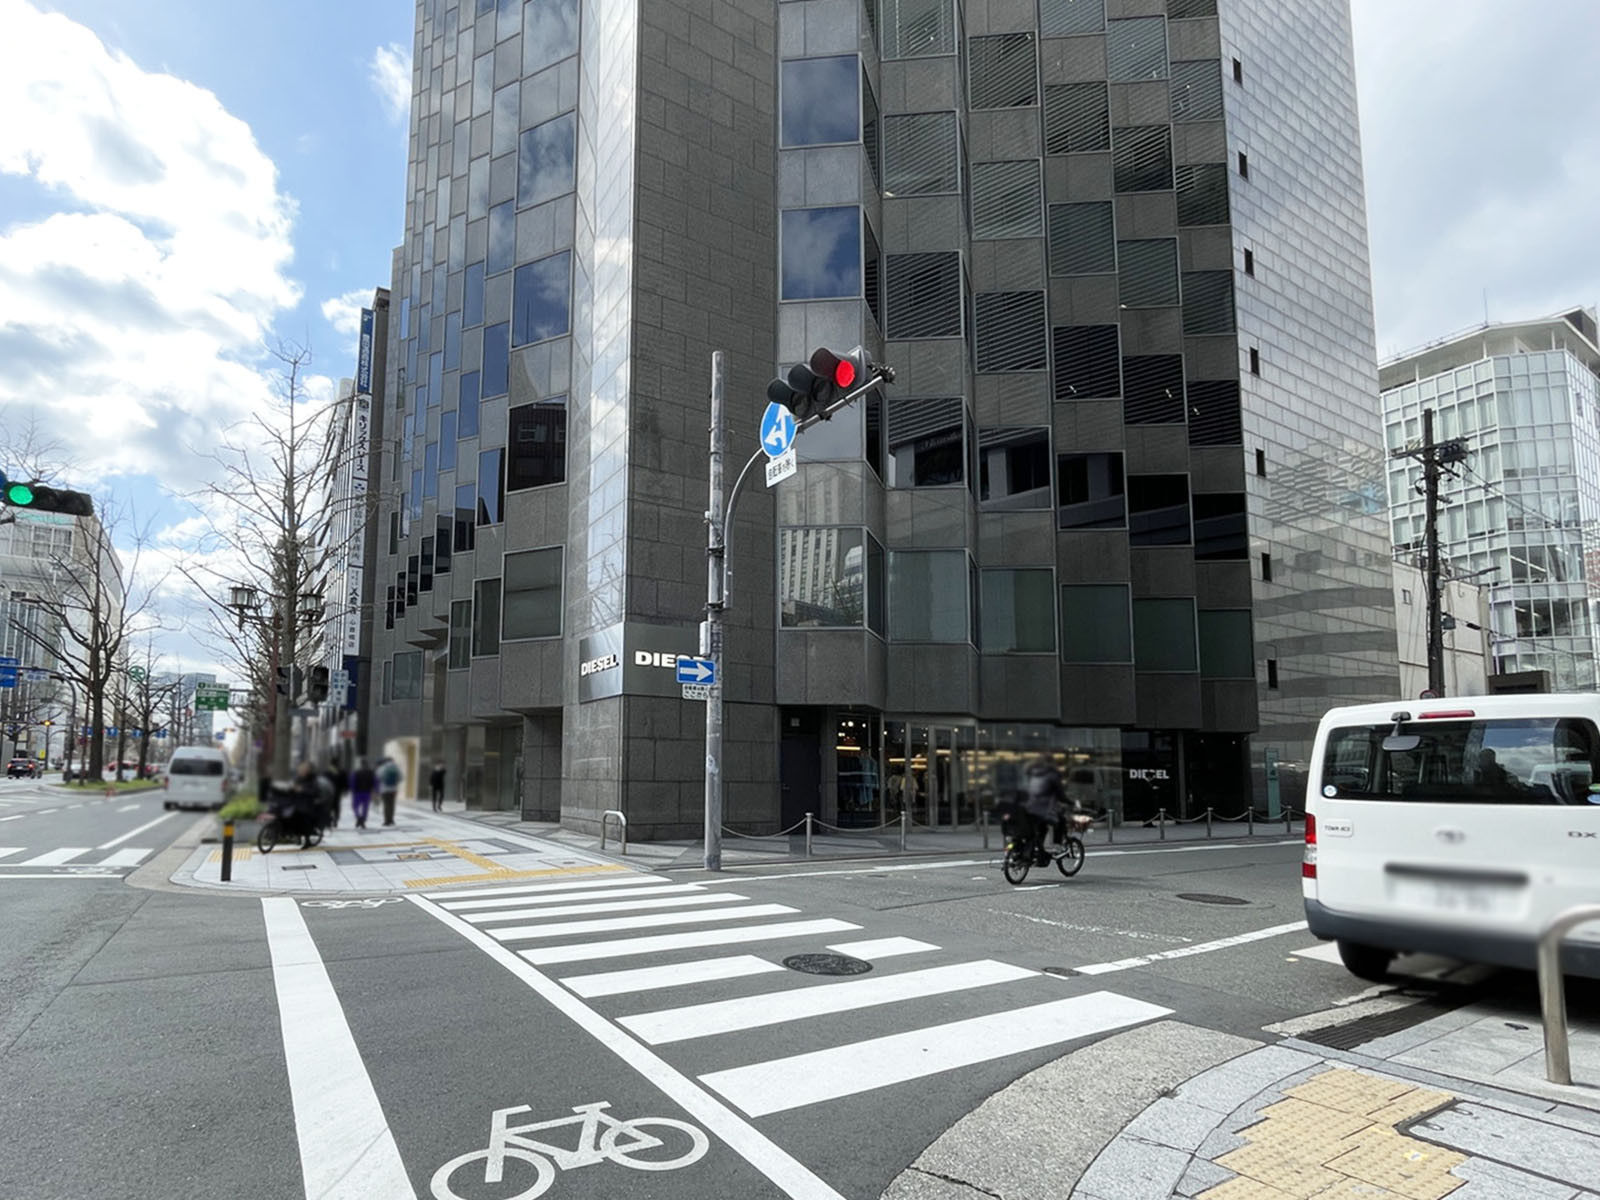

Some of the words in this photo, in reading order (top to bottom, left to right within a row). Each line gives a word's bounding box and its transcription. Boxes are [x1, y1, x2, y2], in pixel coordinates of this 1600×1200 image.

[581, 654, 618, 677] DIESEL
[635, 651, 705, 669] DIE
[1567, 831, 1598, 839] DX
